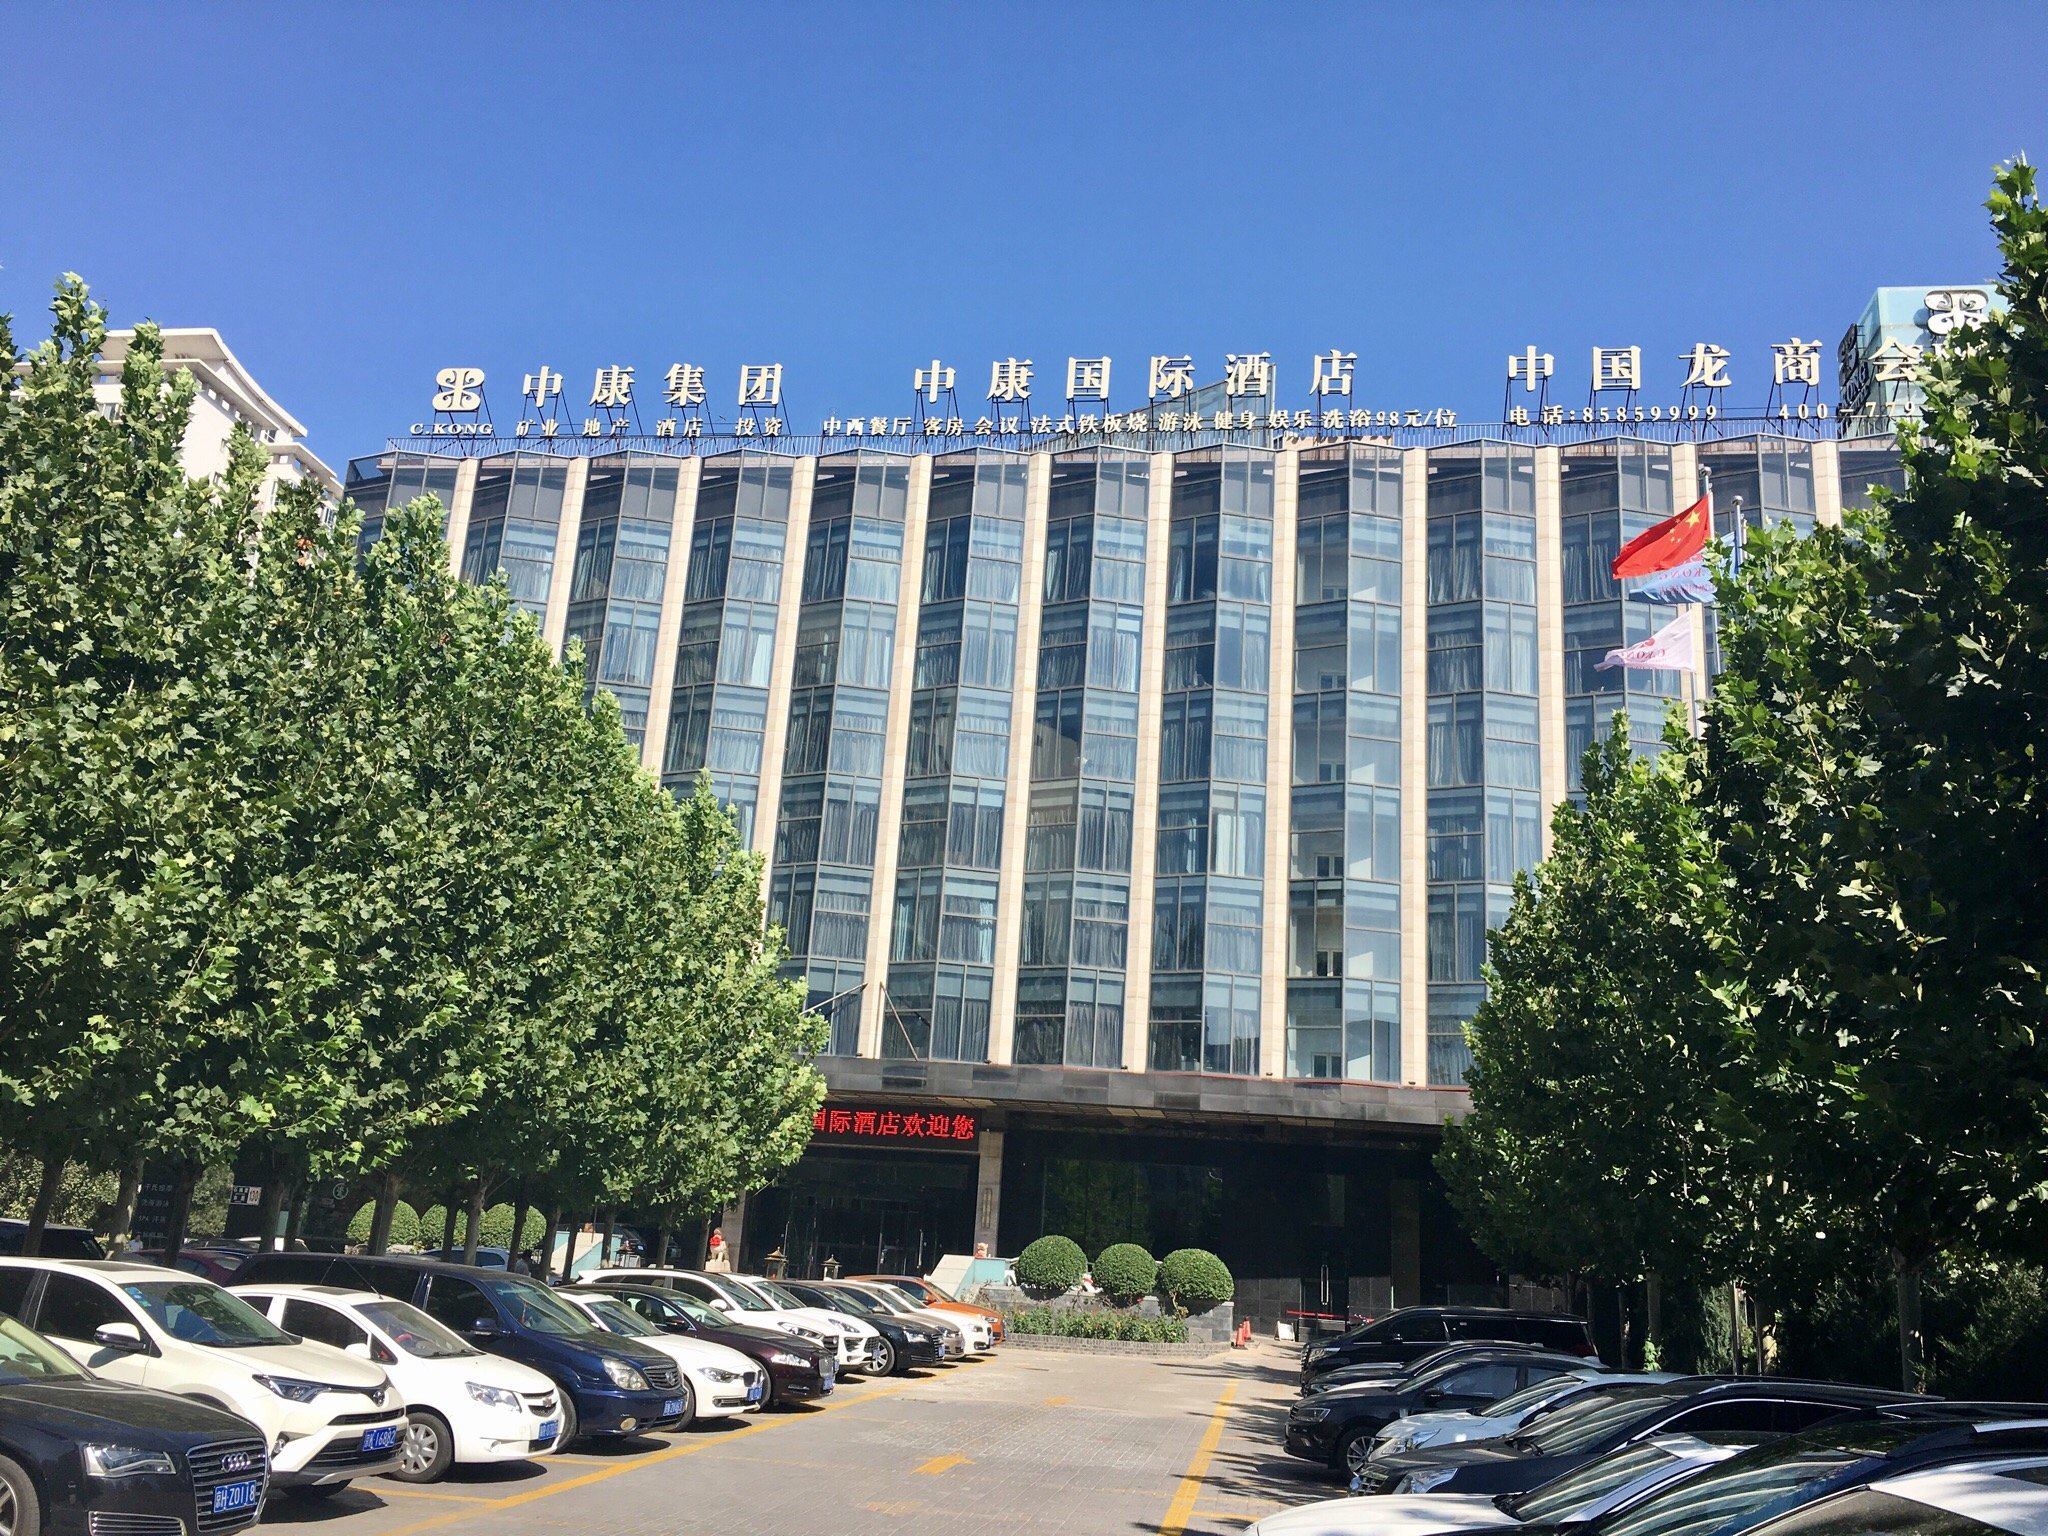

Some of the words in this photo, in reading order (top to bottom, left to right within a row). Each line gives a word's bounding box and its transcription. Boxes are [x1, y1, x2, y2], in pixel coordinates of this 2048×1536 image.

[914, 349, 1357, 403] 中康国际酒店
[1508, 336, 1919, 392] 中国龙商会
[522, 363, 783, 407] 中康集团
[409, 423, 494, 436] C.KONG
[516, 418, 560, 437] 矿业
[582, 418, 631, 437] 地产
[656, 417, 703, 437] 酒店
[735, 416, 783, 437] 投资
[823, 416, 912, 436] 中西餐厅
[924, 416, 964, 436] 客房
[974, 415, 1019, 435] 会议
[1030, 412, 1148, 434] 法式铁板烧
[1158, 411, 1202, 432] 游泳
[1213, 410, 1257, 430] 健身
[1268, 409, 1313, 430] 娱乐
[811, 1108, 975, 1140] 国际酒店欢迎您
